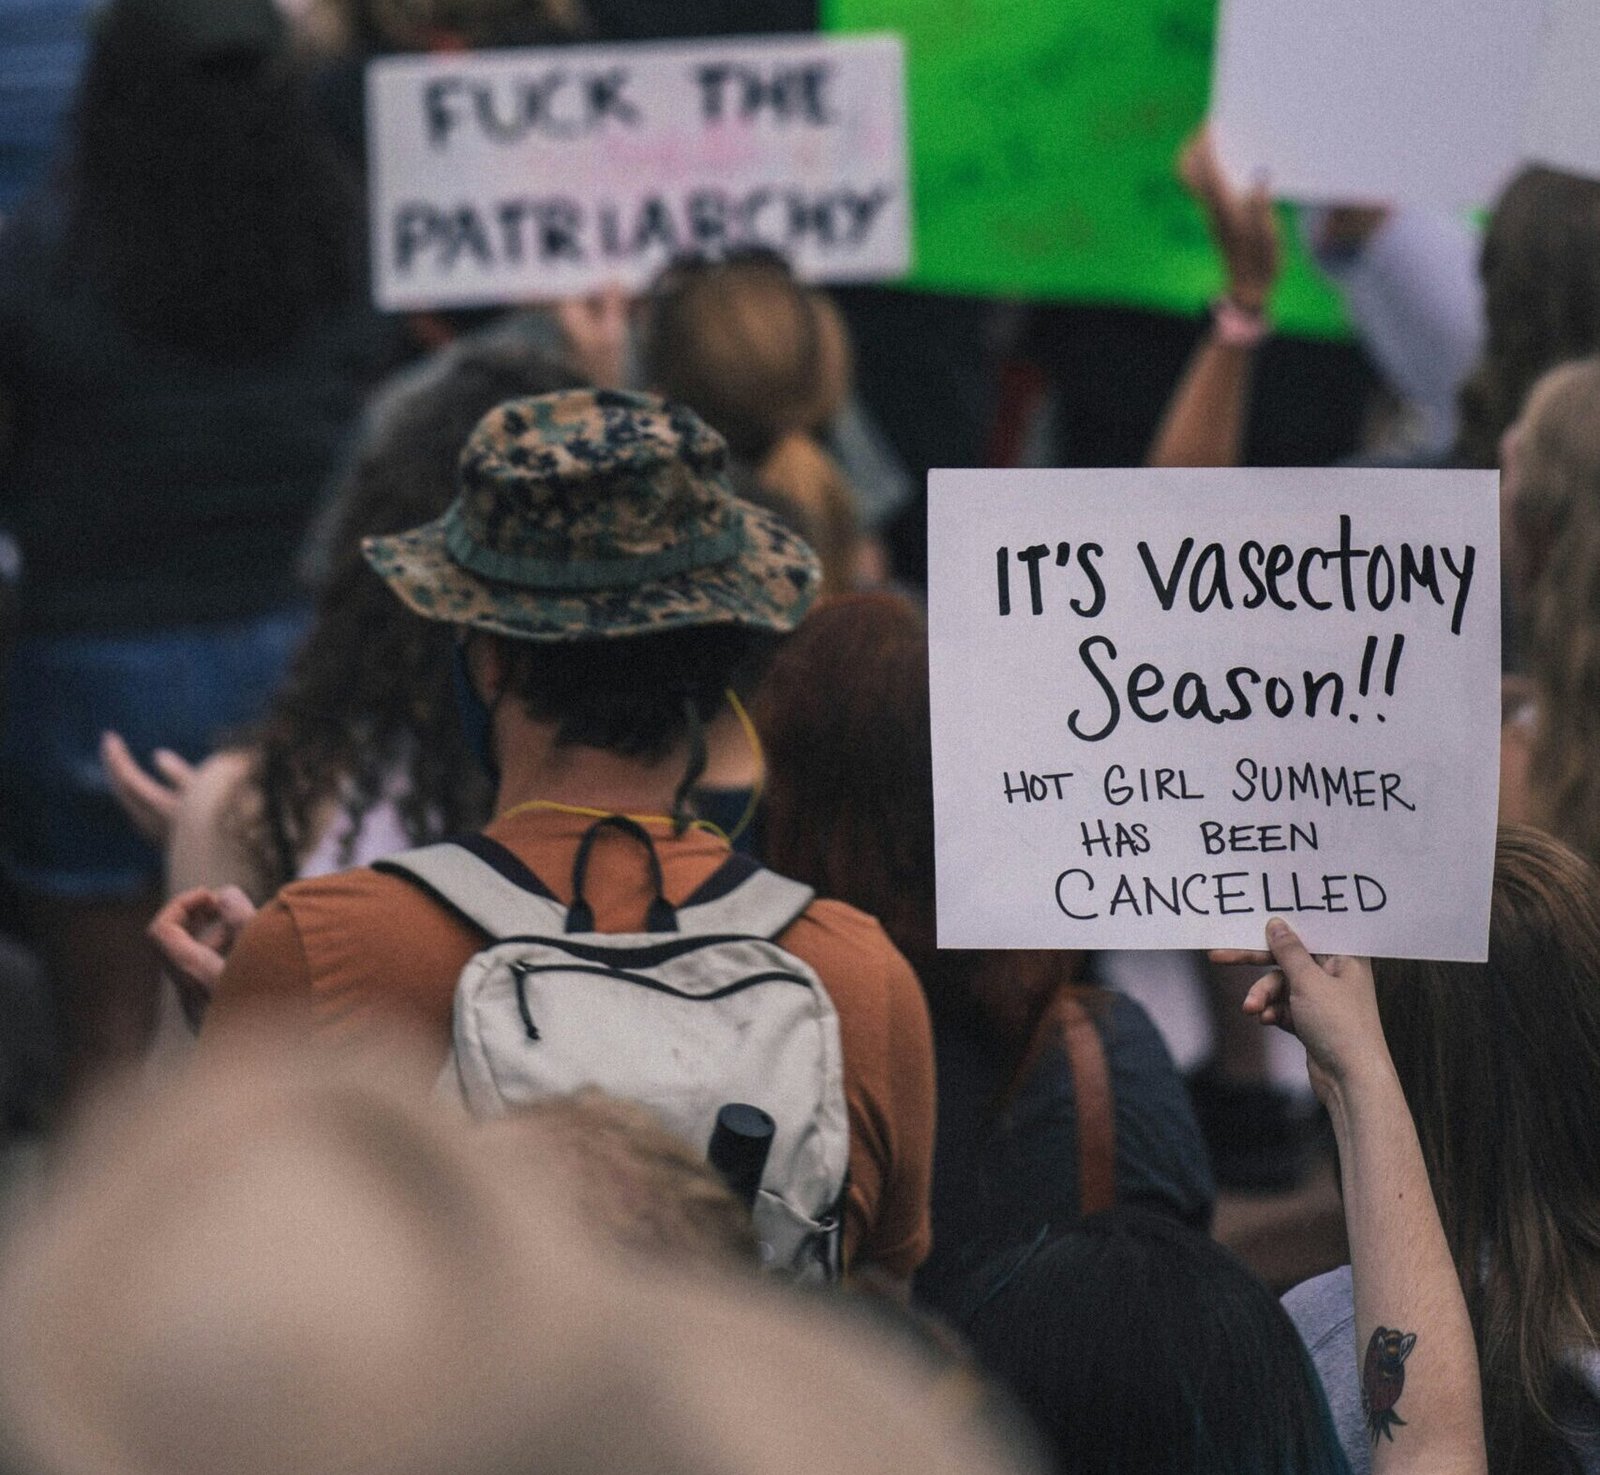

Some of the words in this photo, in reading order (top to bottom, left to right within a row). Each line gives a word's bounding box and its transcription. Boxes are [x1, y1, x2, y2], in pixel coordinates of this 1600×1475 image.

[423, 65, 641, 148] FUCK
[694, 62, 831, 129] THE
[393, 183, 888, 273] PATRIARCHY
[996, 541, 1106, 618] IT'S
[1067, 633, 1405, 742] Season!!
[1003, 769, 1074, 804] HOT
[1103, 764, 1205, 806] GIRL
[1232, 757, 1416, 812] SUMMER
[1080, 819, 1151, 858] HAS
[1199, 821, 1319, 855] BEEN
[1055, 868, 1387, 920] CANCELLED
